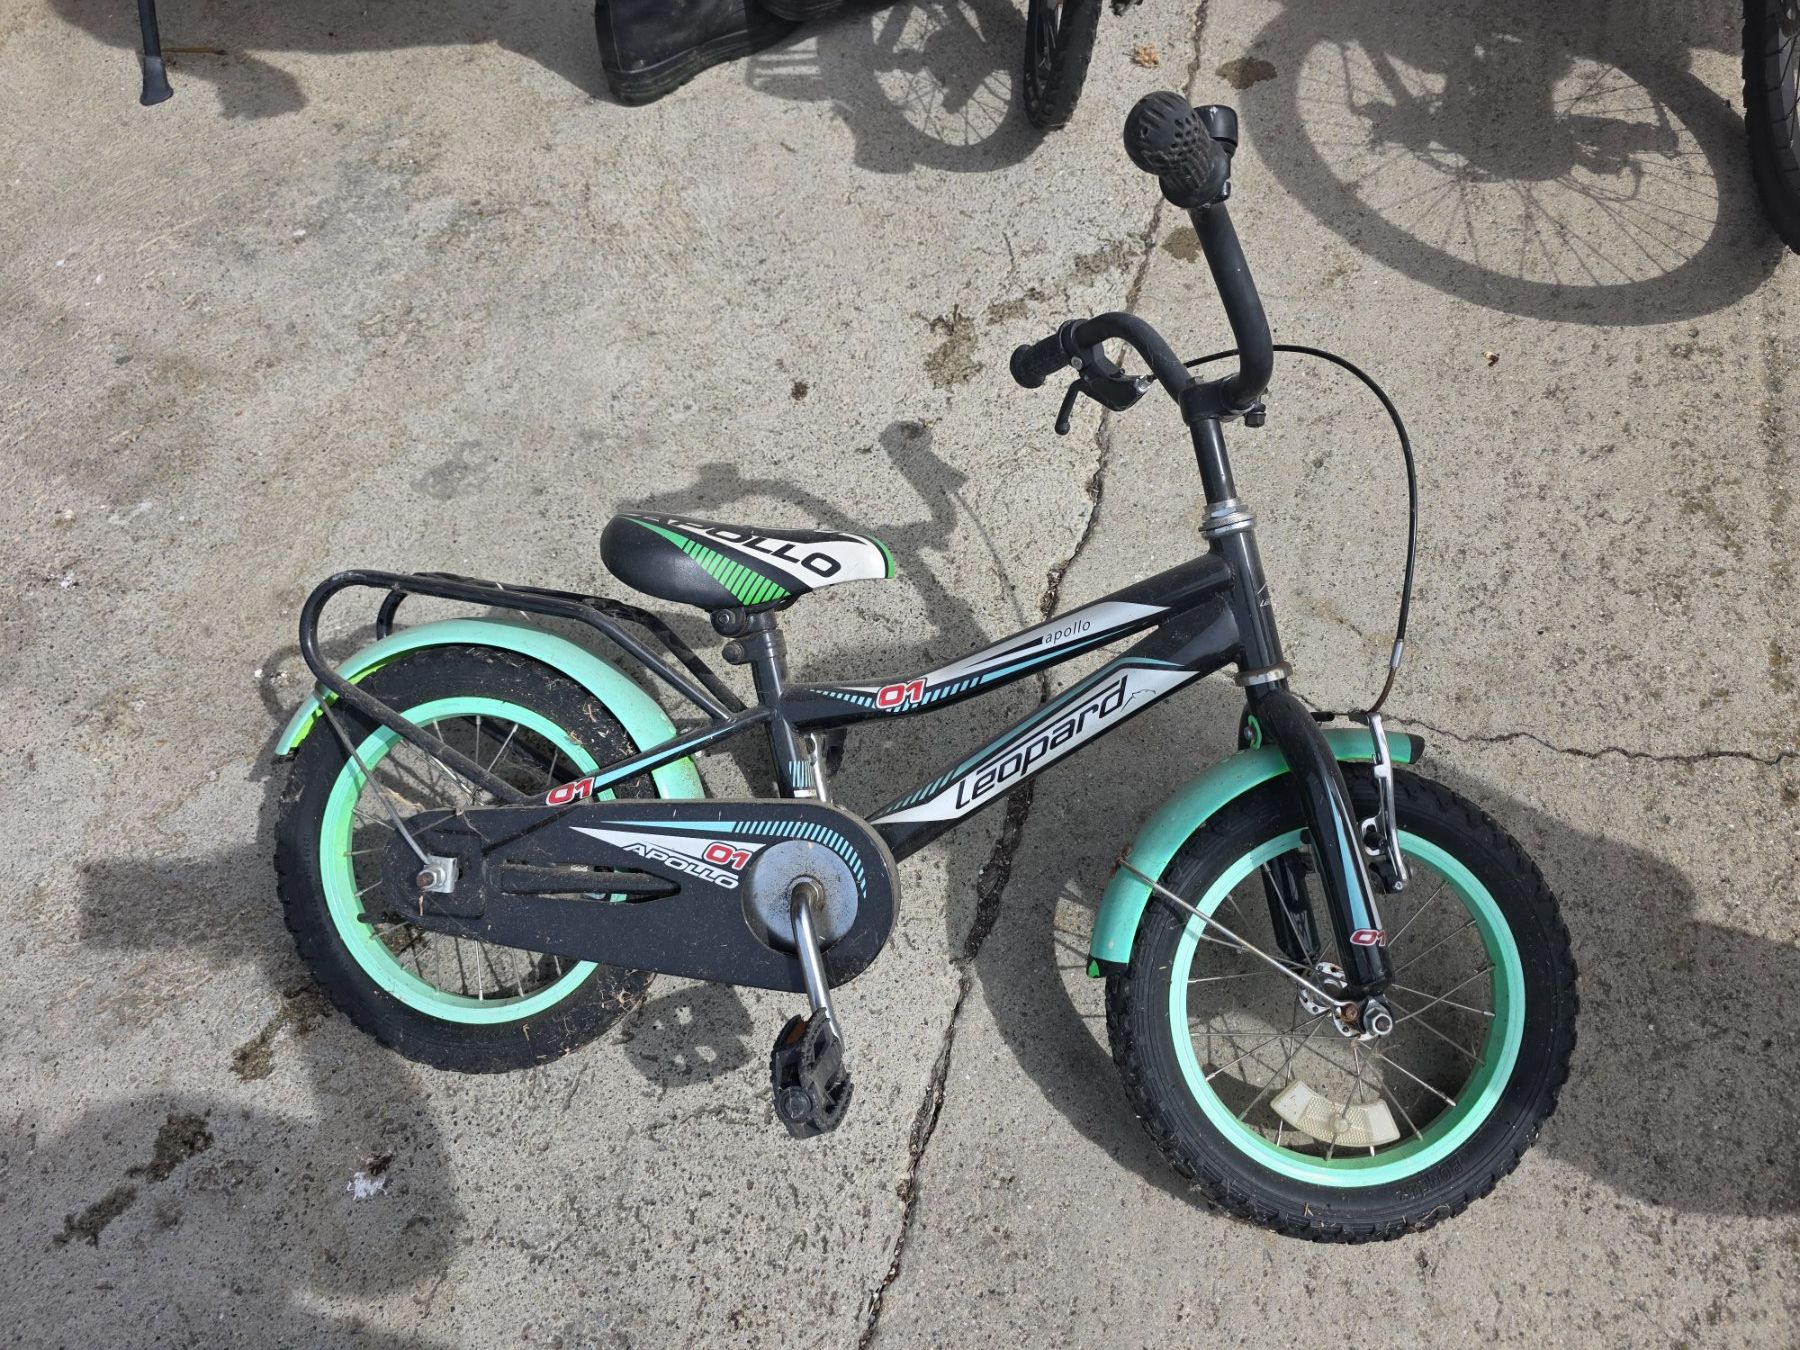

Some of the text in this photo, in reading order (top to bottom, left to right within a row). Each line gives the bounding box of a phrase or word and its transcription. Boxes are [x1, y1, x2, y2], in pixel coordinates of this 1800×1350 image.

[657, 518, 842, 578] POLLO
[1045, 619, 1091, 645] apollo
[876, 678, 927, 709] 01
[955, 674, 1129, 810] Leopard
[546, 776, 595, 806] 01
[623, 842, 740, 889] APOLLO
[702, 842, 753, 871] 01
[1350, 928, 1387, 947] 01
